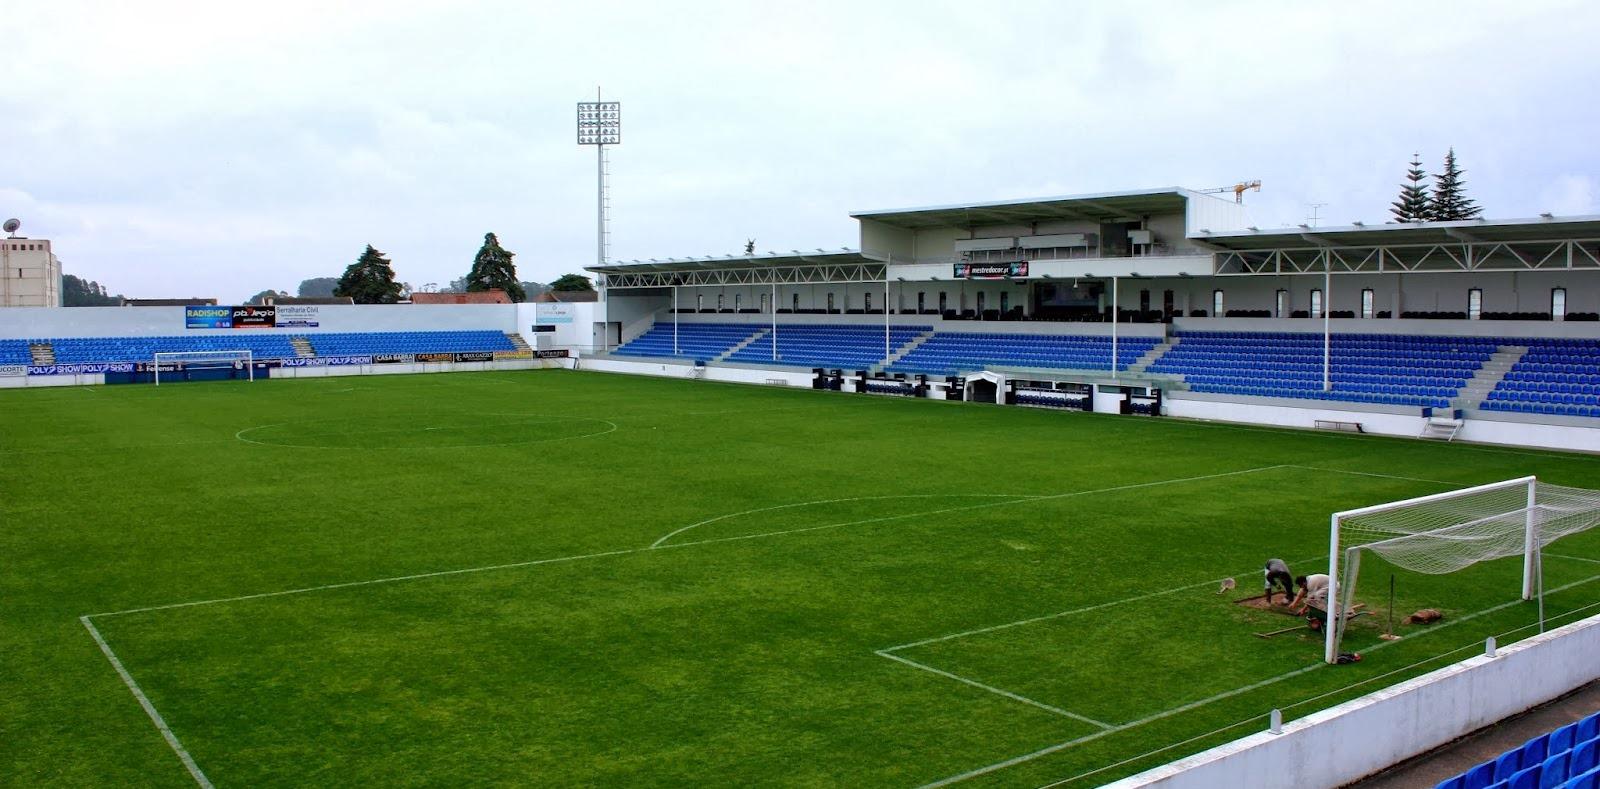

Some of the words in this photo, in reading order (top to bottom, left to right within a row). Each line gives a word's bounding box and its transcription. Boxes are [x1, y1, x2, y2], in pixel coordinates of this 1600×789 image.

[972, 266, 1009, 275] mestredocor.pt
[187, 309, 229, 317] RADISHOP
[277, 306, 305, 314] Serralharia
[306, 306, 319, 314] Civil
[282, 358, 299, 366] POLY
[350, 356, 370, 364] SHOW
[27, 366, 50, 374] POLY
[56, 365, 80, 373] SHOW
[82, 364, 103, 372] POLY
[110, 363, 134, 372] SHOW
